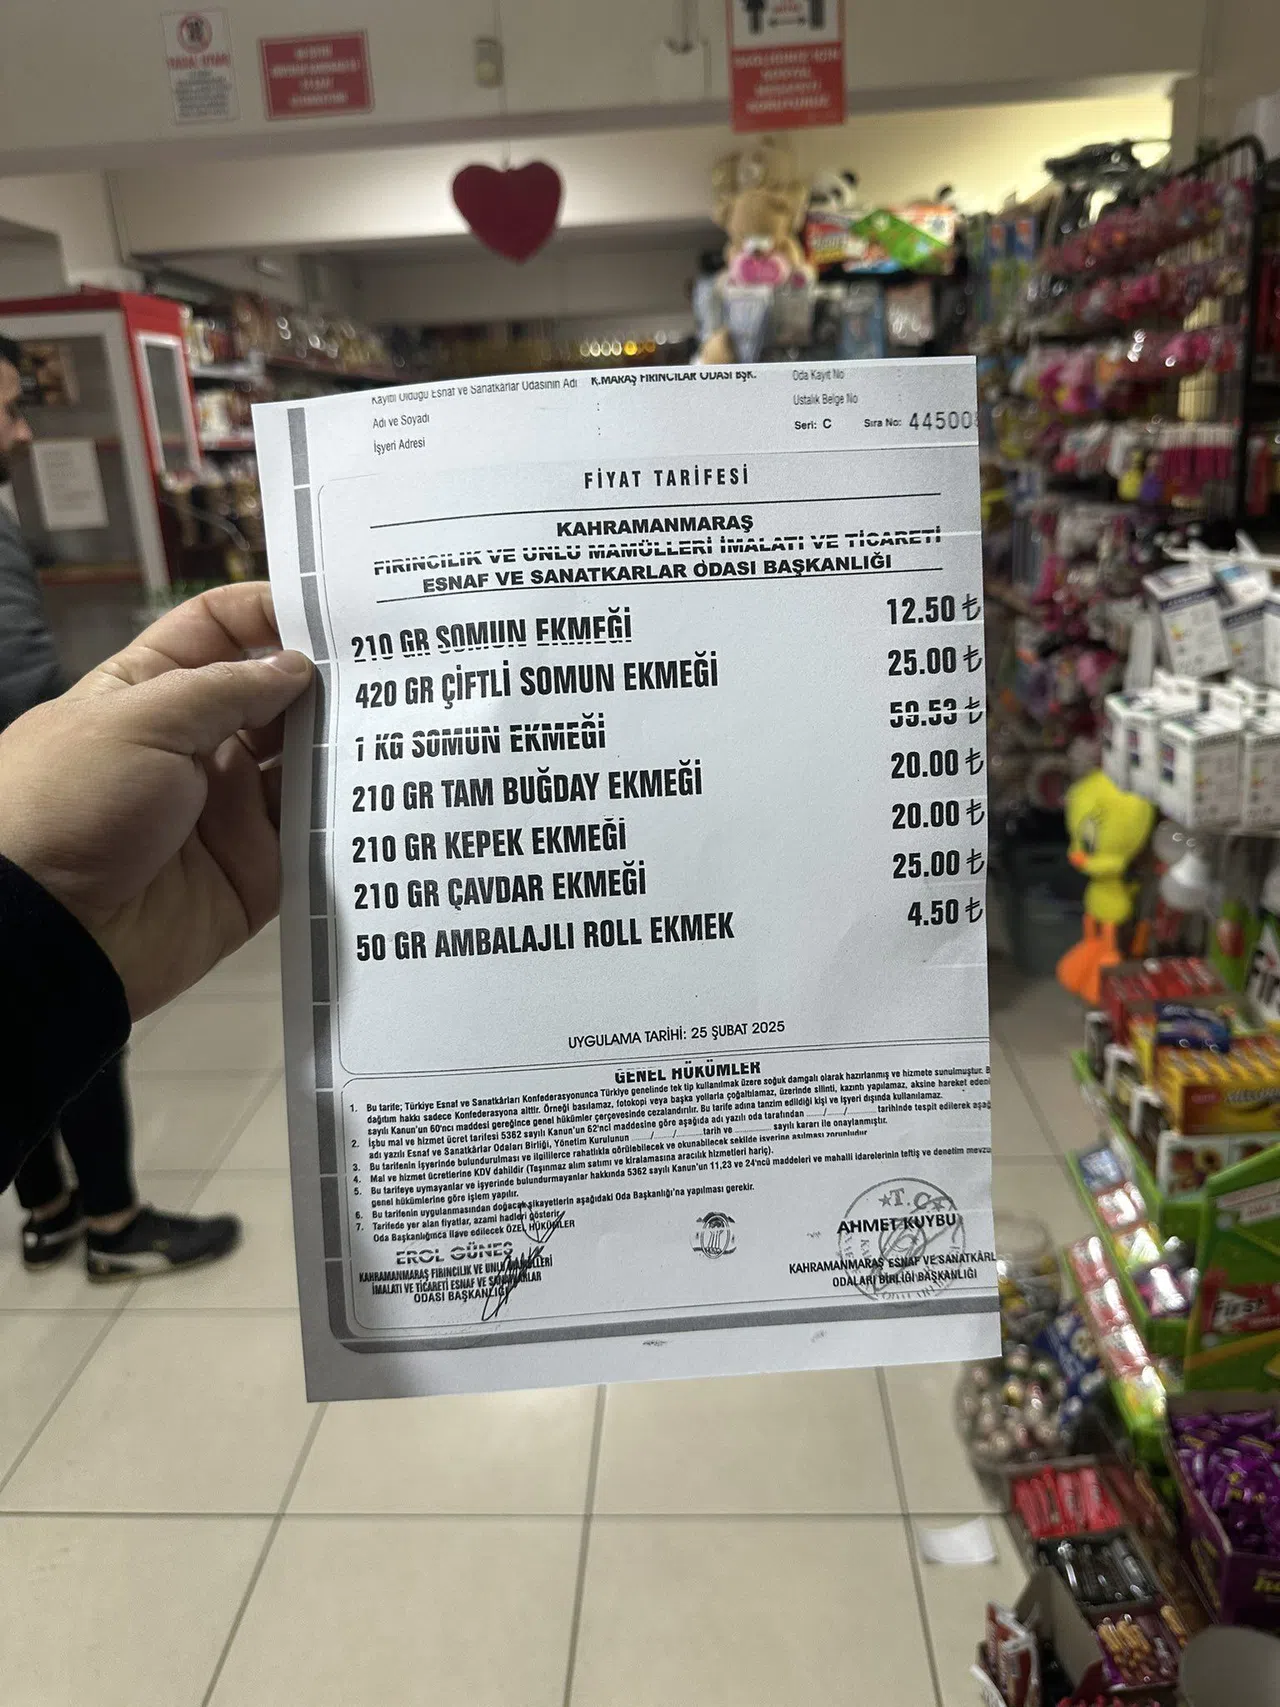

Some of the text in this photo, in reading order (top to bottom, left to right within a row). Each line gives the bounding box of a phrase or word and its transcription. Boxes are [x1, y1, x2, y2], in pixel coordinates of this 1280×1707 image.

[457, 386, 468, 395] ve
[563, 378, 578, 388] Adı
[792, 369, 844, 382] Oda Kayıt No
[793, 393, 858, 406] Ustalık Belge No
[373, 413, 430, 429] Adı ve Soyadı
[794, 419, 832, 430] Seri: C
[864, 418, 883, 428] Sıra
[885, 417, 901, 427] No:
[373, 437, 425, 456] İşyeri Adresi
[584, 463, 748, 489] FİYAT TARİFESİ
[557, 514, 754, 537] KAHRAMANMARAŞ
[486, 548, 516, 564] VE
[589, 536, 712, 559] MAMÜLLERİ
[811, 534, 839, 549] VE
[845, 525, 941, 548] TİCARETİ
[423, 551, 891, 593] ESNAF VE SANATKARLAR ODASI BAŞKANLIĞI
[887, 595, 955, 625] 12.50
[351, 606, 632, 663] 210 GR SOMUN EKMEĞİ
[887, 646, 957, 677] 25.00
[355, 651, 718, 710] 420 GR ÇİFTLİ SOMUN EKMEĞİ
[355, 712, 606, 762] 1 KG SOMUN EKMEĞİ
[891, 749, 959, 779] 20.00
[352, 759, 703, 813] 210 GR TAM BUĞDAY EKMEĞİ
[892, 800, 959, 830] 20.00
[352, 817, 626, 863] 210 GR KEPEK EKMEĞİ
[893, 849, 960, 879] 25.00
[354, 860, 647, 911] 210 GR ÇAVDAR EKMEĞİ
[907, 898, 959, 926] 4.50
[356, 911, 734, 962] 50 GR AMBALAJLI ROLL EKMEK
[568, 1020, 785, 1049] UYGULAMA TARİHİ: 25 ŞUBAT 2025
[615, 1059, 761, 1084] GENEL HÜKÜMLER
[350, 1104, 358, 1112] 1.
[366, 1103, 377, 1112] Bu
[404, 1100, 434, 1111] Türkiye
[436, 1099, 458, 1109] Esnaf
[522, 1090, 599, 1104] Konfederasyonunca
[601, 1088, 630, 1099] Türkiye
[631, 1085, 668, 1096] genelinde
[670, 1083, 682, 1092] tek
[684, 1082, 694, 1093] tip
[696, 1079, 739, 1089] kullanılmak
[741, 1078, 762, 1086] üzere
[764, 1076, 786, 1086] soğuk
[788, 1074, 819, 1085] damgalı
[820, 1072, 844, 1081] olarak
[845, 1070, 889, 1081] hazırlanmış
[902, 1068, 933, 1077] hizmete
[353, 1175, 361, 1184] 4.
[370, 1174, 385, 1183] Mal
[399, 1172, 426, 1181] hizmet
[428, 1169, 472, 1179] ücretlerine
[473, 1168, 491, 1177] KDV
[493, 1165, 524, 1175] dahildir
[526, 1162, 567, 1174] (Taşınmaz
[569, 1161, 586, 1169] alım
[587, 1159, 612, 1168] satımı
[625, 1154, 675, 1165] kiralamasına
[677, 1152, 707, 1162] aracılık
[708, 1148, 746, 1159] hizmetleri
[748, 1146, 774, 1157] hariç).
[371, 1190, 519, 1208] genel hükümlerine göre işlem yapılır.
[837, 1213, 956, 1234] AHMET KUYBU
[359, 1268, 429, 1283] KAHRAMANMARAŞ
[431, 1264, 472, 1278] FIRINCILIK
[473, 1263, 483, 1275] VE
[789, 1258, 884, 1274] KAHRAMANMARAŞ
[888, 1256, 920, 1268] ESNAF
[924, 1255, 938, 1265] VE
[832, 1268, 977, 1287] ODALARI BİRLİĞİ BAŞKANLIĞI
[372, 1282, 402, 1295] İMALATI
[404, 1281, 413, 1293] VE
[415, 1278, 449, 1292] TİCARETİ
[450, 1278, 475, 1290] ESNAF
[477, 1276, 487, 1288] VE
[414, 1292, 445, 1303] ODASI
